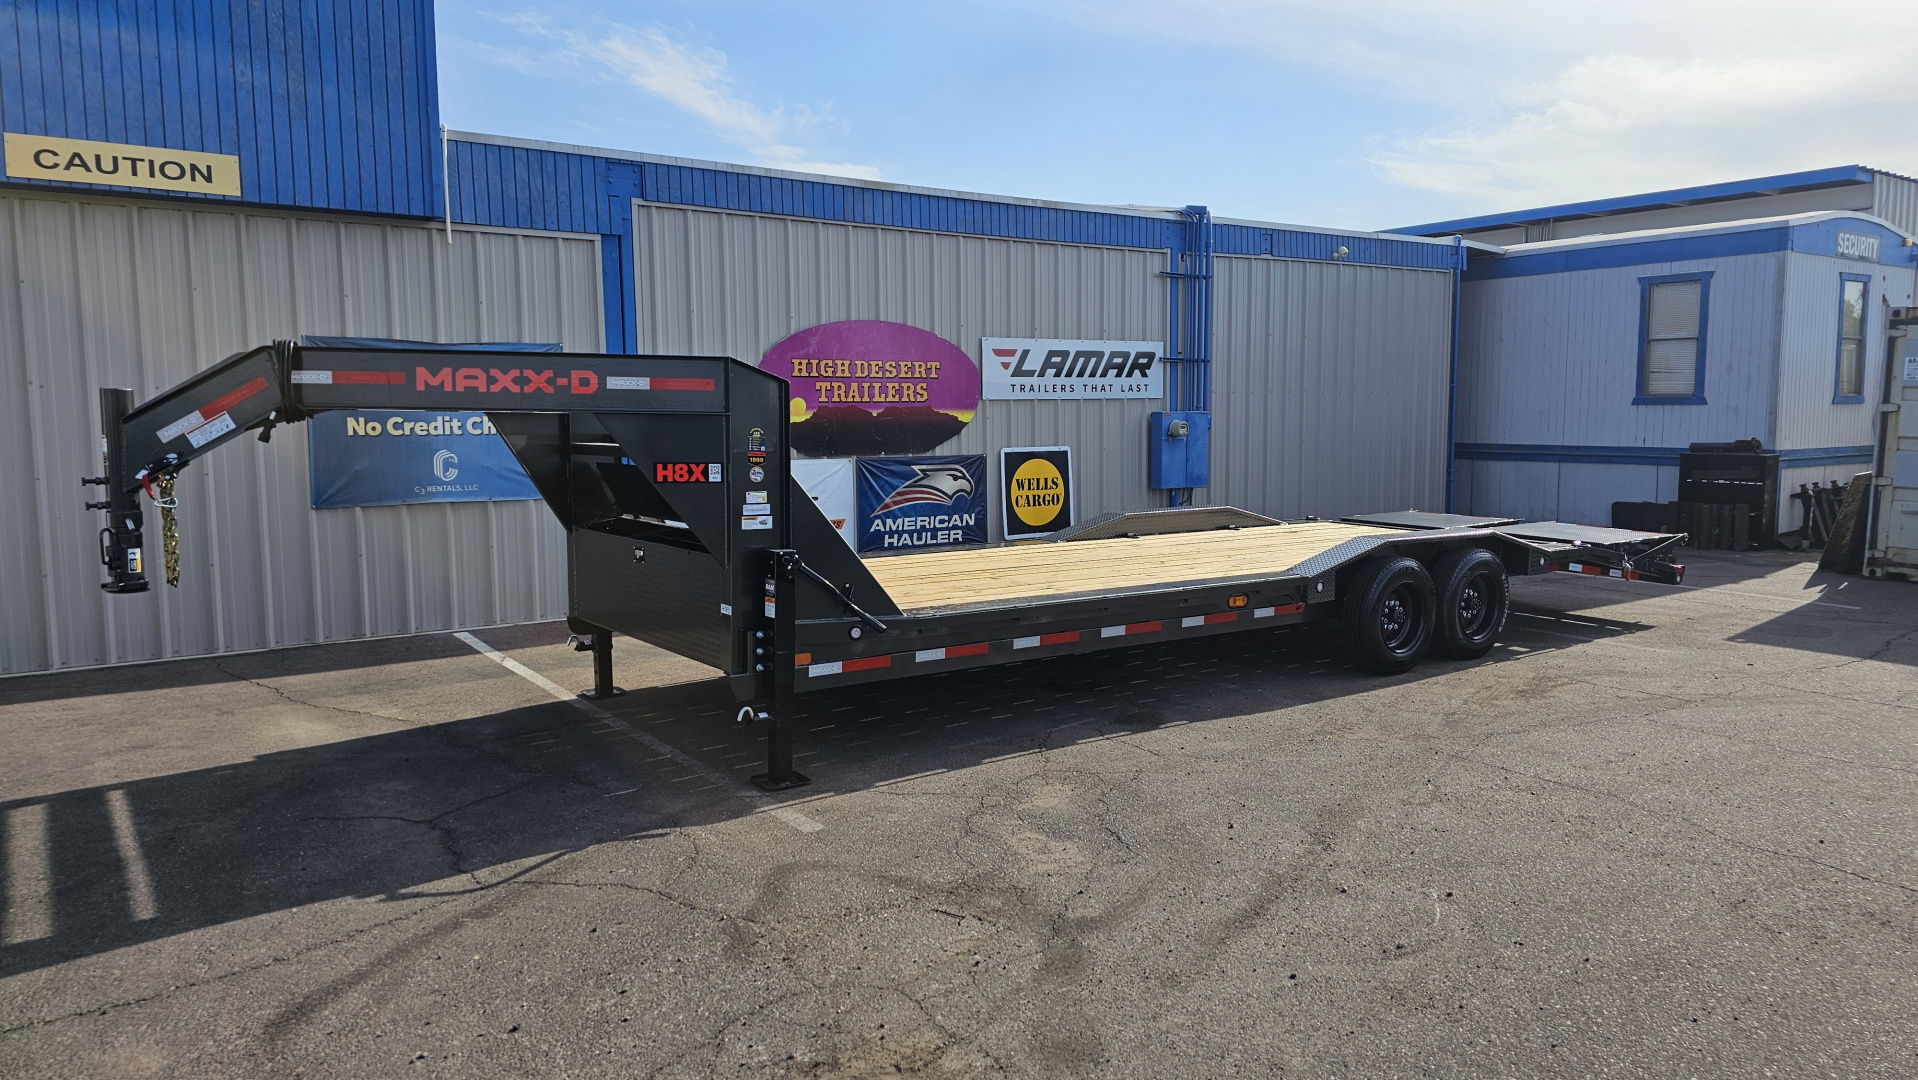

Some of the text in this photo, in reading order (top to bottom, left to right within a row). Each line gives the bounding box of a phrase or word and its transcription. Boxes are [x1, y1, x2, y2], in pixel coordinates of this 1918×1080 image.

[33, 149, 213, 184] CAUTION
[1838, 233, 1879, 258] SECURITY
[791, 358, 941, 379] HIGH DESERT
[1010, 348, 1157, 378] LAMAR
[415, 366, 599, 394] MAXX-D
[1010, 383, 1149, 393] TRAILERS THAT LAST
[815, 381, 929, 403] TRAILERS
[346, 416, 497, 437] No Credit Ch
[656, 463, 707, 482] H8X
[426, 484, 463, 492] RENTALS,
[1015, 476, 1059, 491] WELLS
[1014, 492, 1061, 508] CARGO
[869, 513, 975, 533] AMERICAN
[883, 529, 963, 548] HAULER
